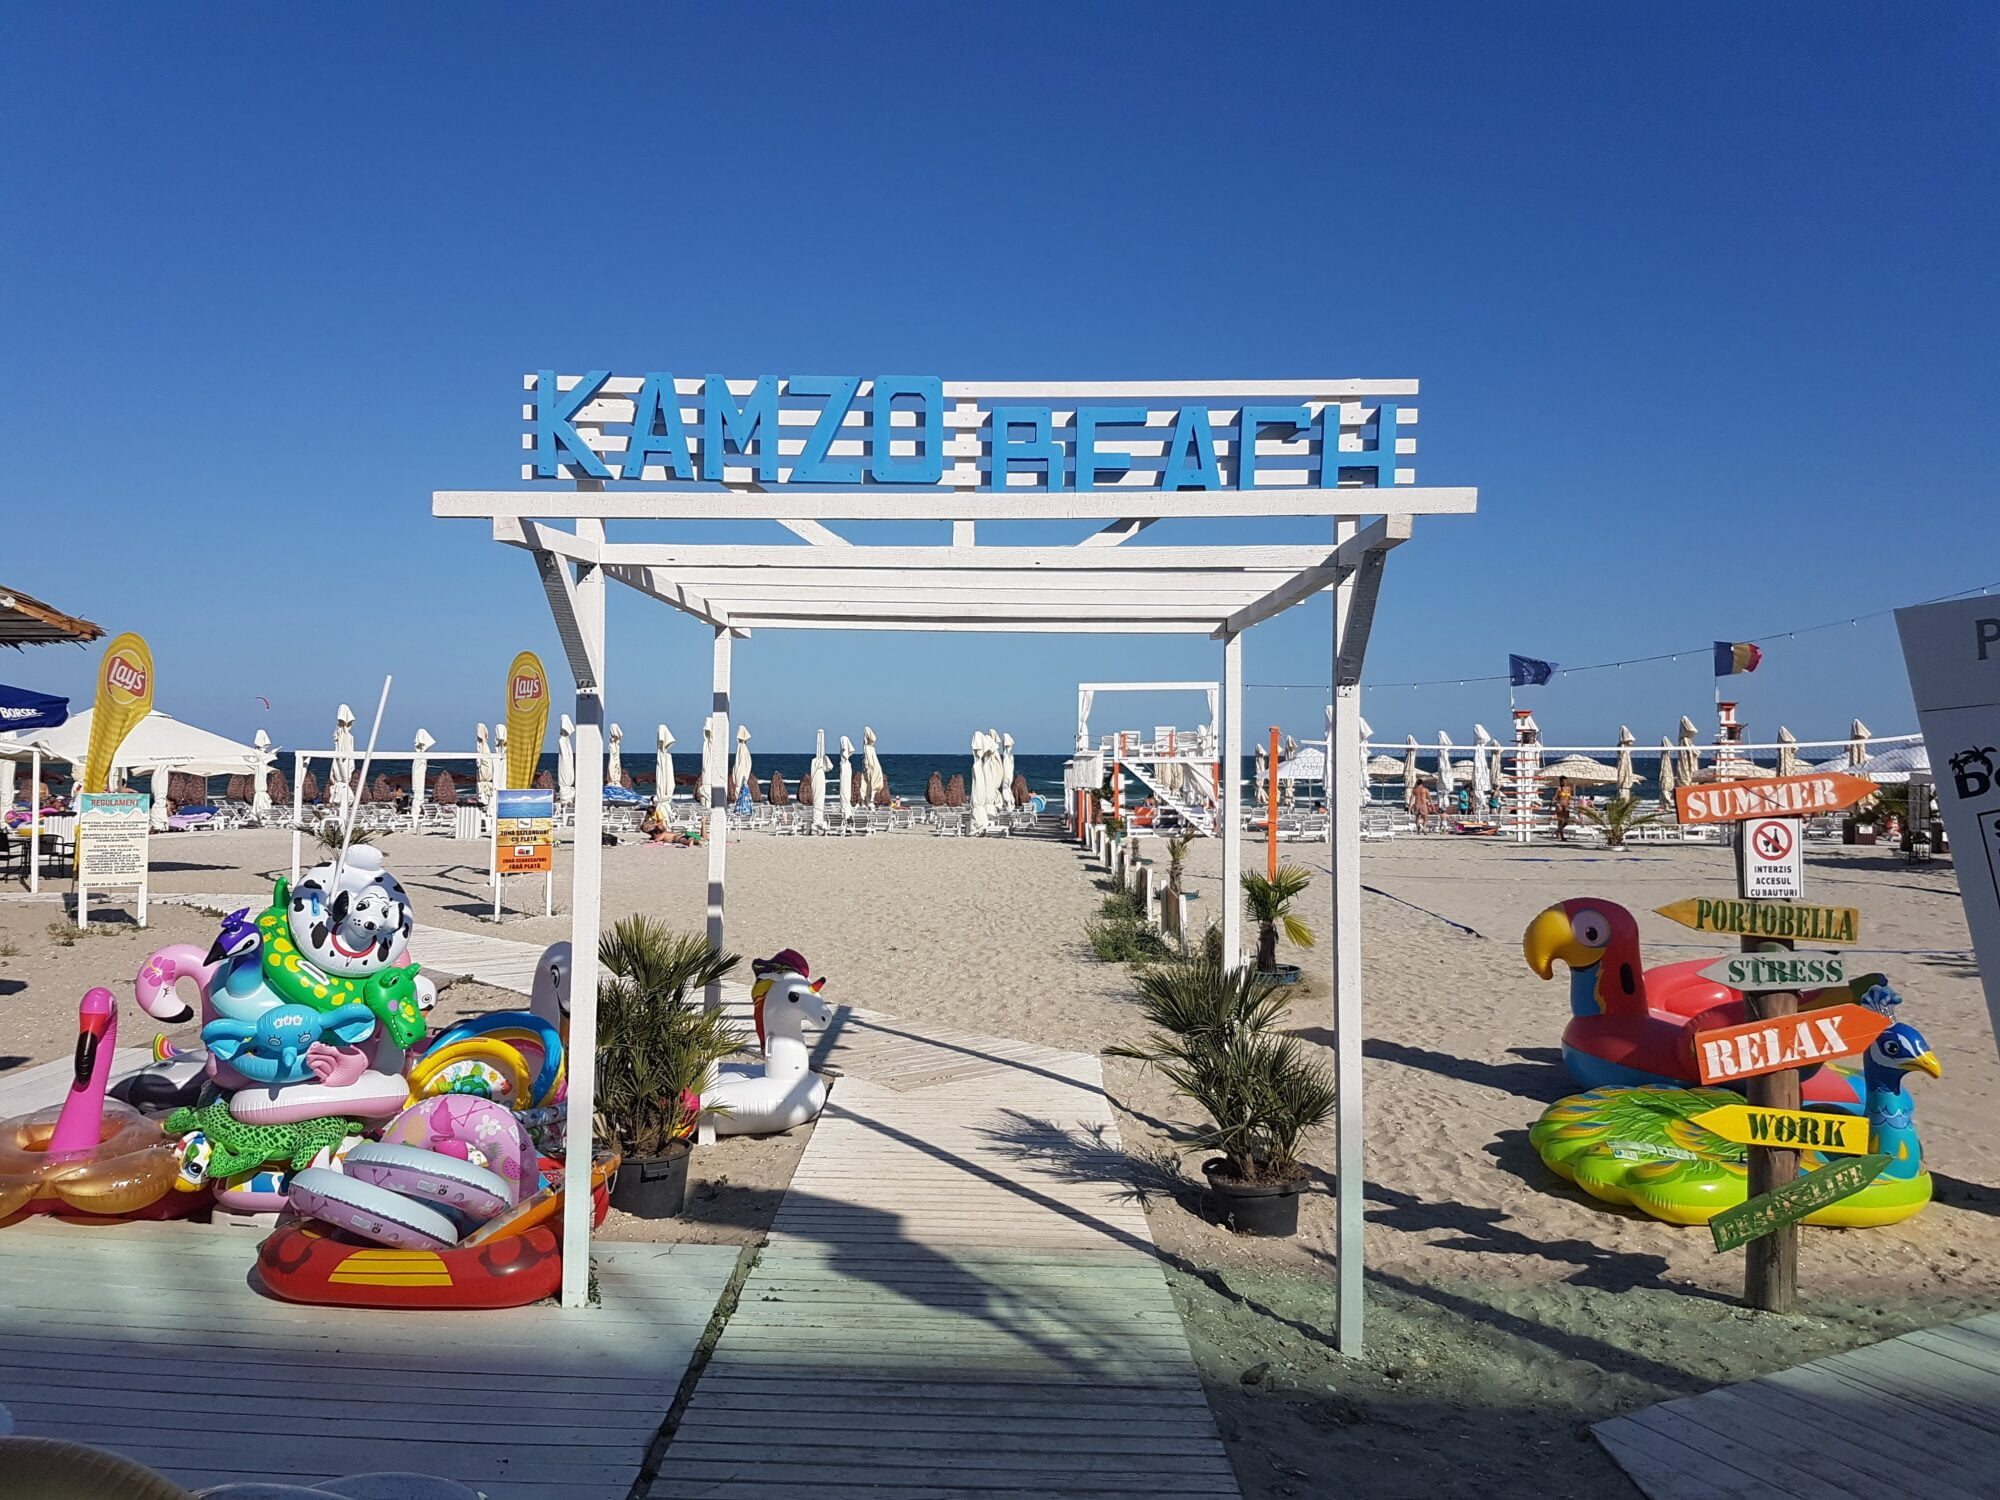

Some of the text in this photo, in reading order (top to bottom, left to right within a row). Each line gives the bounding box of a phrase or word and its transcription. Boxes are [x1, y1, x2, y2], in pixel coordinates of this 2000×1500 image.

[537, 369, 1397, 493] KAMZO BEACH
[109, 658, 144, 690] Lay's
[515, 677, 540, 699] Lay's
[1686, 778, 1838, 820] SUMMER
[1754, 865, 1792, 873] INTERZIS
[1755, 877, 1791, 885] ACCESUL
[1695, 899, 1854, 941] PORTOBELLA
[1728, 959, 1843, 983] STRESS
[1702, 1015, 1848, 1079] RELAX
[1747, 1112, 1846, 1147] WORK
